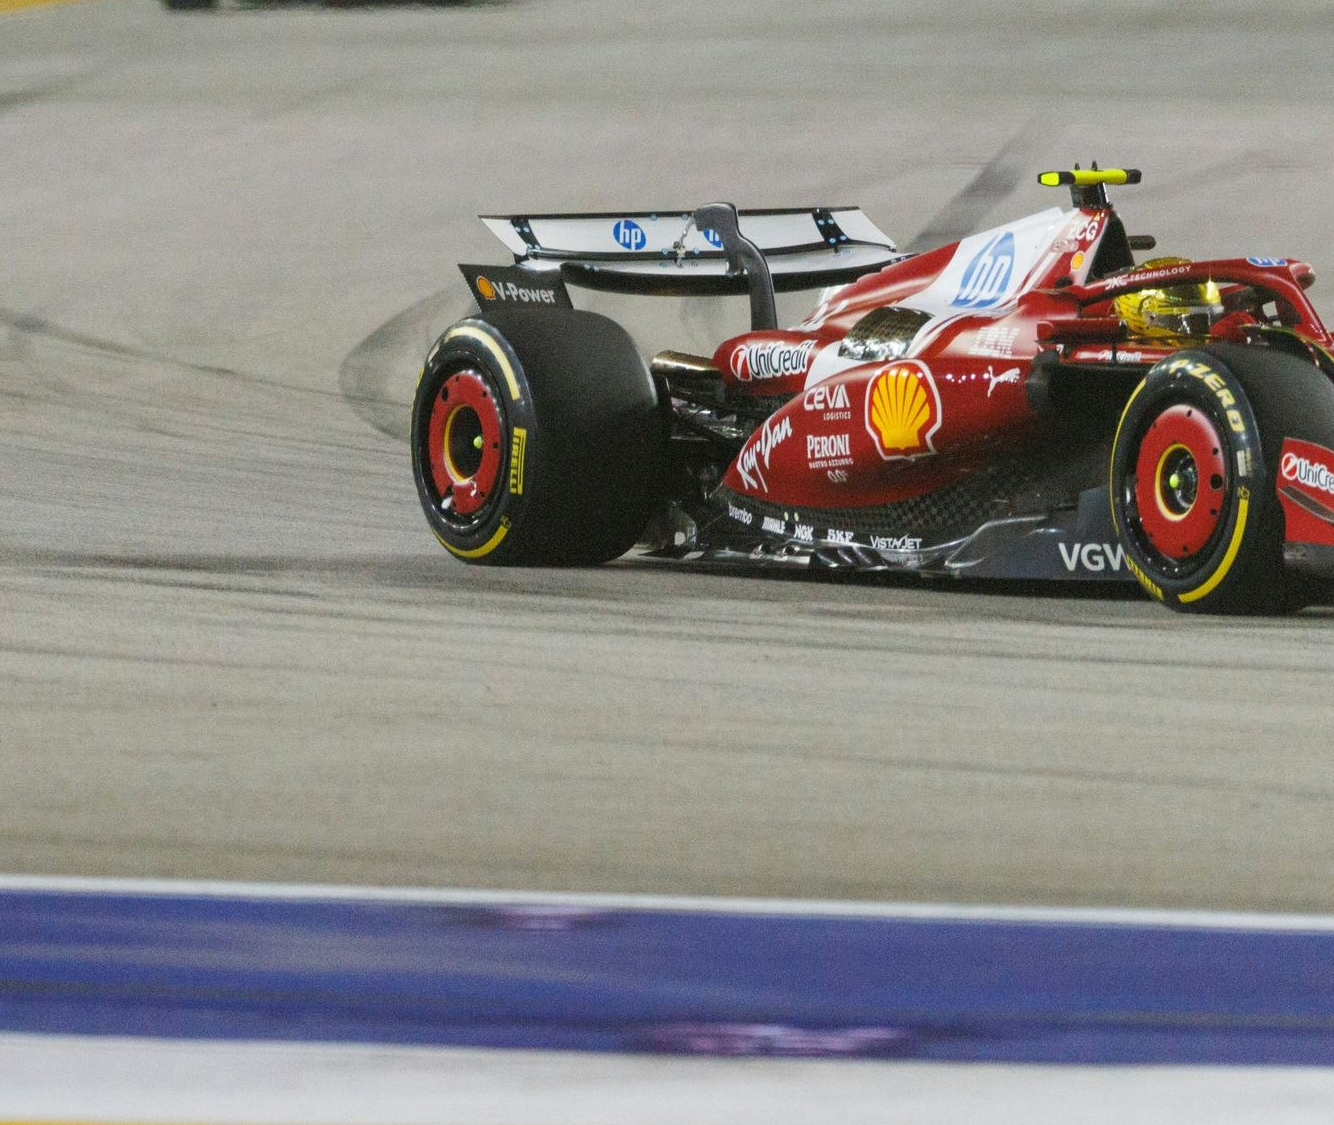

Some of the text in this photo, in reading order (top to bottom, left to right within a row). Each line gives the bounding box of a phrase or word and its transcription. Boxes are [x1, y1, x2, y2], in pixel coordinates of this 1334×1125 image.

[615, 220, 644, 251] hp
[952, 232, 1014, 308] hp
[1130, 265, 1191, 282] TECHNOLOGY
[493, 282, 555, 304] V-Power
[969, 327, 1019, 358] IBM
[748, 339, 816, 377] UniCredit
[1189, 361, 1246, 432] ZERO
[823, 410, 851, 421] LOGISTICS
[806, 434, 850, 459] PERONI
[728, 501, 753, 525] brembo
[794, 524, 814, 542] NGK
[827, 528, 854, 543] SKF
[1058, 542, 1132, 572] VGW
